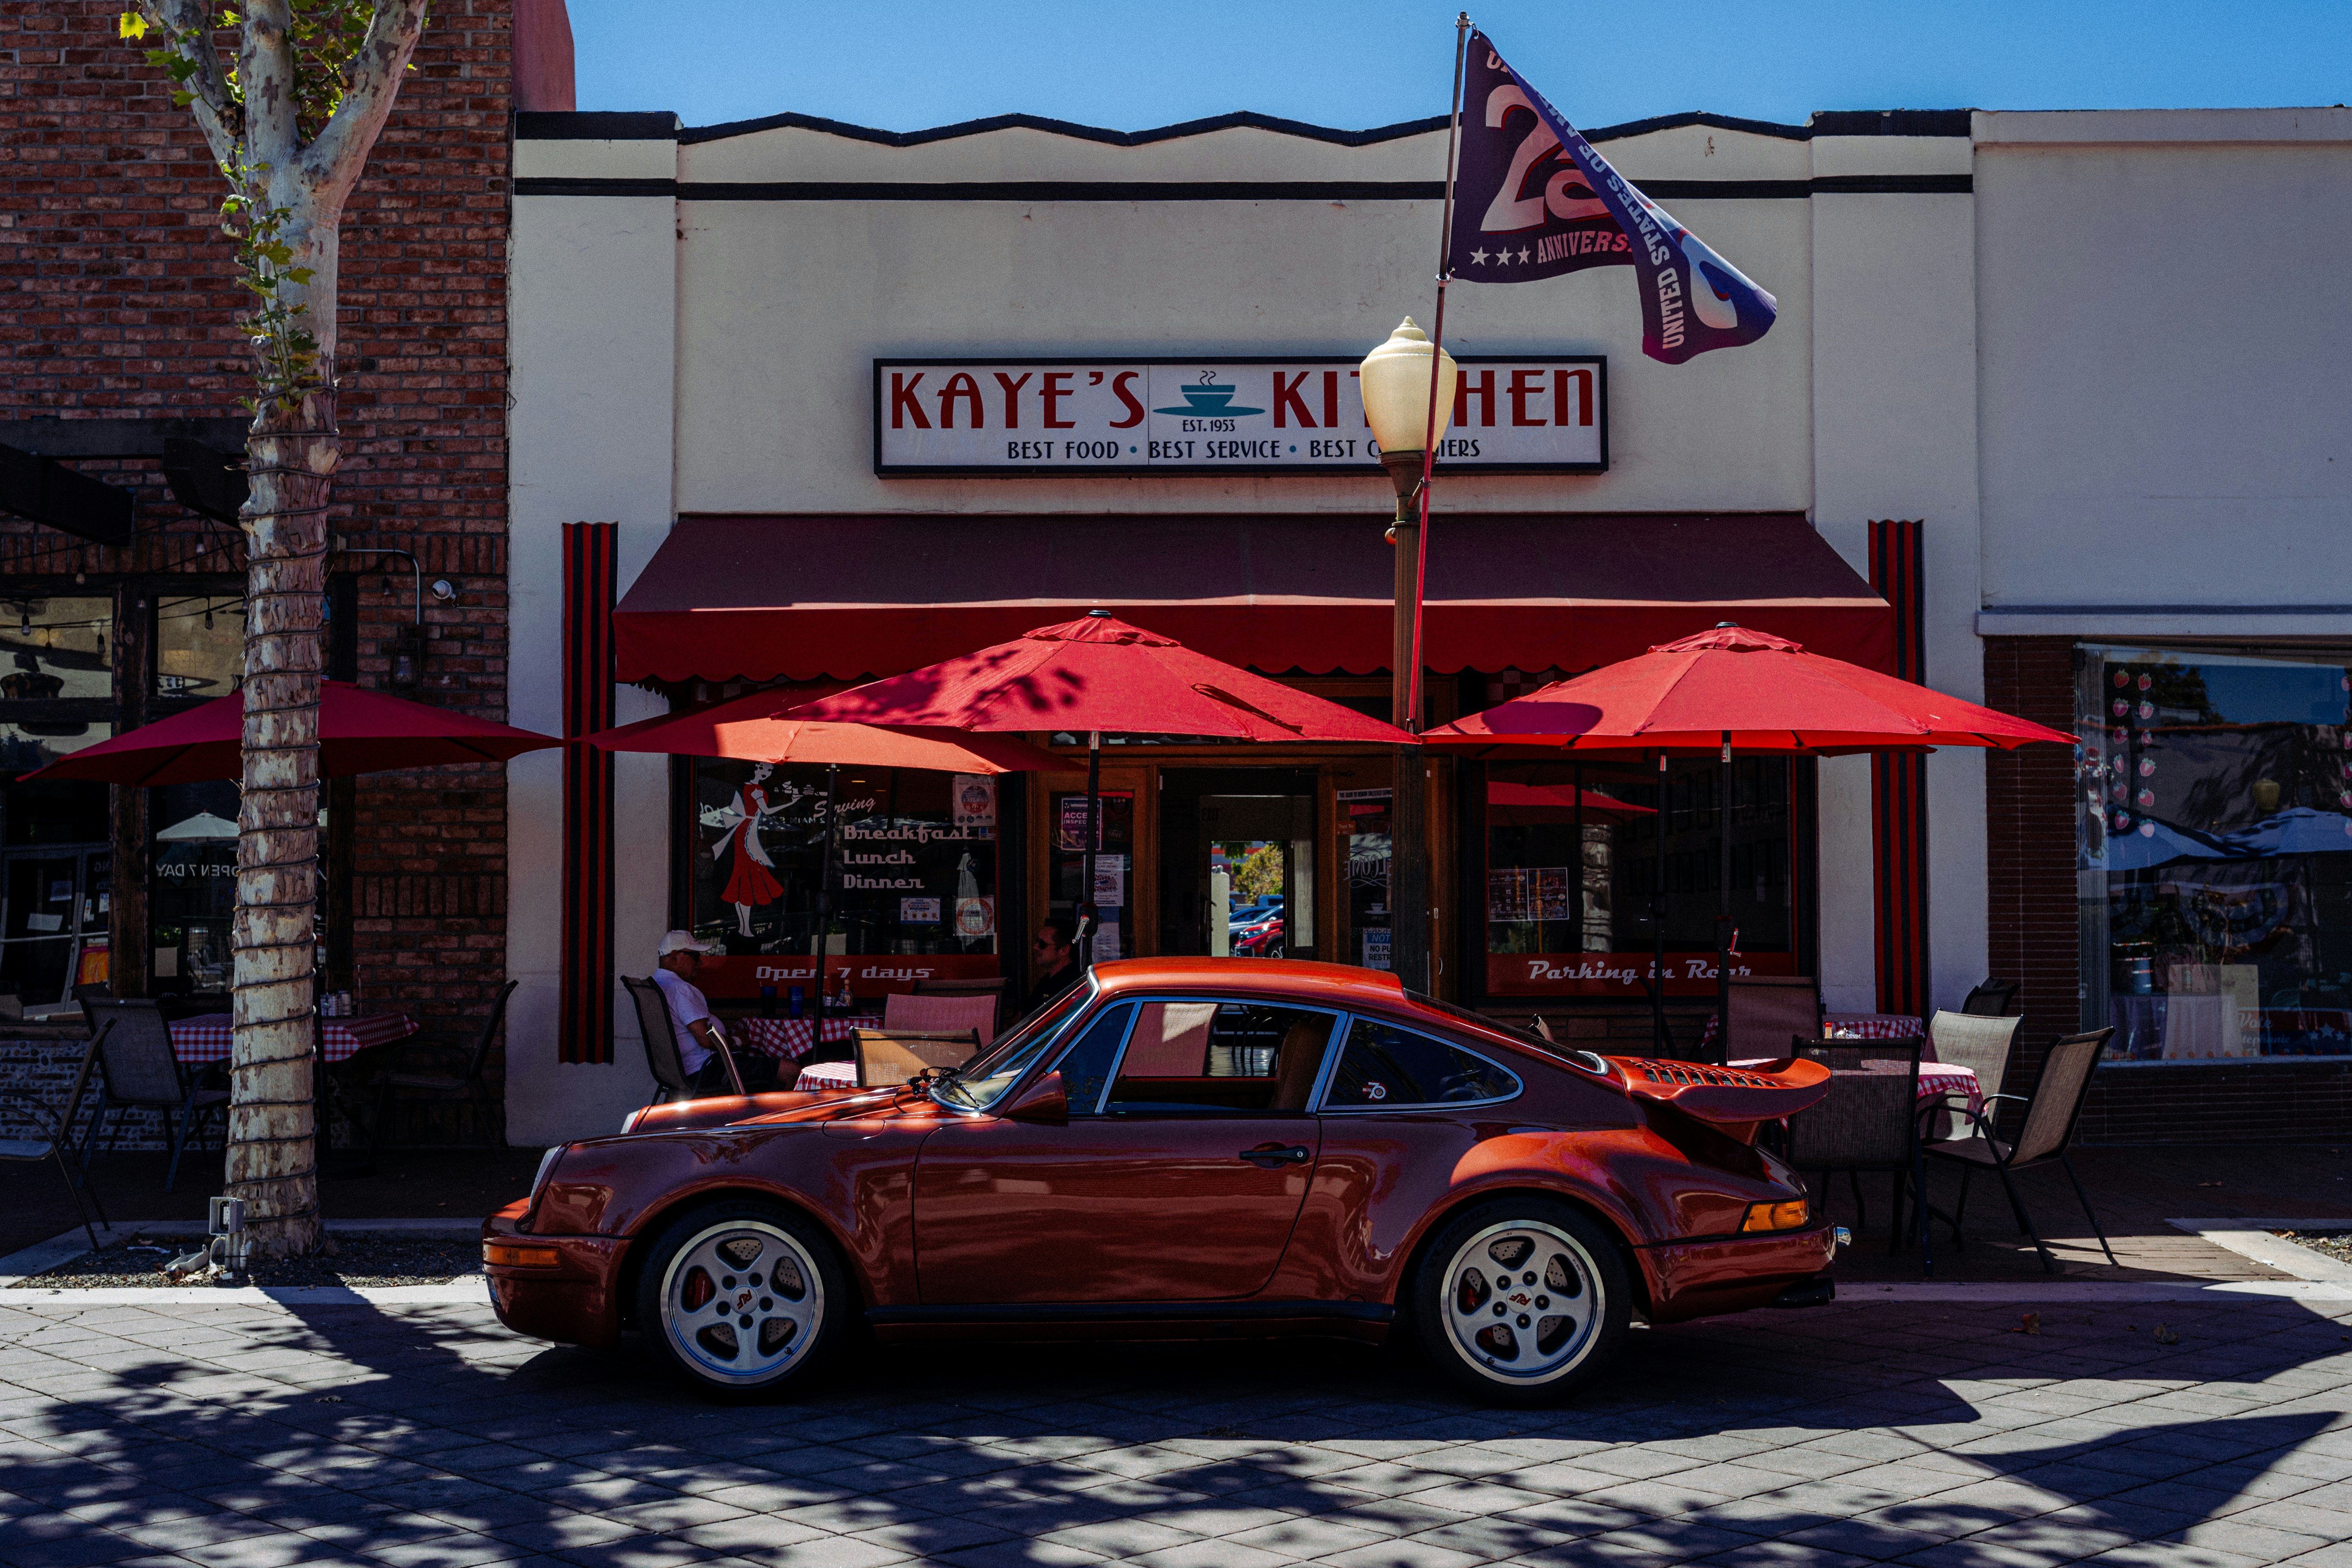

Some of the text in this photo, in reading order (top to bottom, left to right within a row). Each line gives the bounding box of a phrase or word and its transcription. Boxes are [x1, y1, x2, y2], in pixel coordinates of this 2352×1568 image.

[1606, 175, 1670, 266] STATES
[1537, 231, 1632, 264] ANNIVERS
[1658, 268, 1685, 350] UNITED
[892, 369, 1594, 429] KAYE'S KIHEN
[1008, 441, 1055, 459] BEST
[1065, 441, 1119, 459] FOOD
[1149, 441, 1195, 459] BEST
[1206, 440, 1281, 458] SERVICE
[1310, 439, 1356, 458] BEST
[814, 797, 876, 819] Srving
[844, 824, 973, 844] Breakfast
[844, 849, 916, 865] Lunch
[844, 874, 925, 889] Dinner
[1371, 934, 1391, 942] NOT
[837, 967, 851, 979] 7
[862, 966, 935, 981] days
[1527, 960, 1639, 985] Parking
[2239, 1012, 2272, 1029] Vote
[2240, 1034, 2291, 1044] tephanie
[1368, 1082, 1386, 1099] 70
[736, 1203, 806, 1230] MICHELIN
